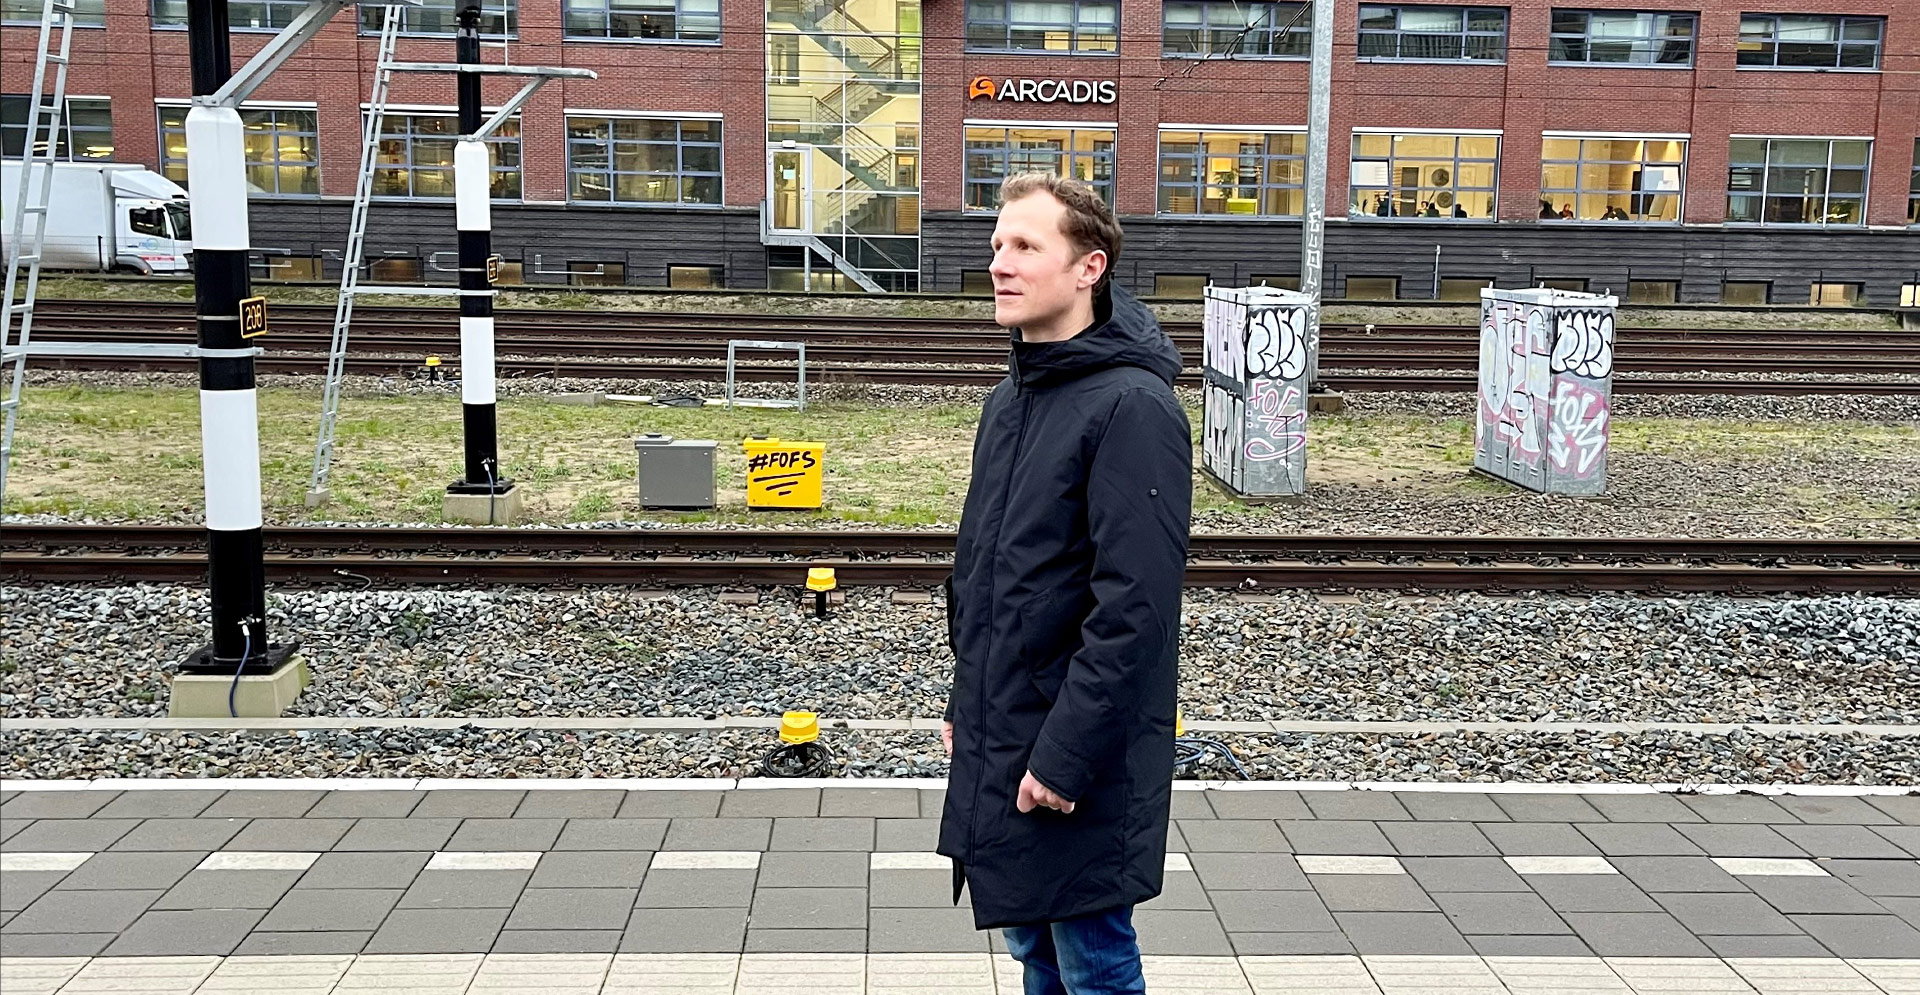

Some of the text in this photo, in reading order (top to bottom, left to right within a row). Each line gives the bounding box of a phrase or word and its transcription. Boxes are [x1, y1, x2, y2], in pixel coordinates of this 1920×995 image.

[997, 79, 1117, 104] ARCADIS
[245, 304, 263, 331] 208
[748, 450, 816, 473] #FOFS
